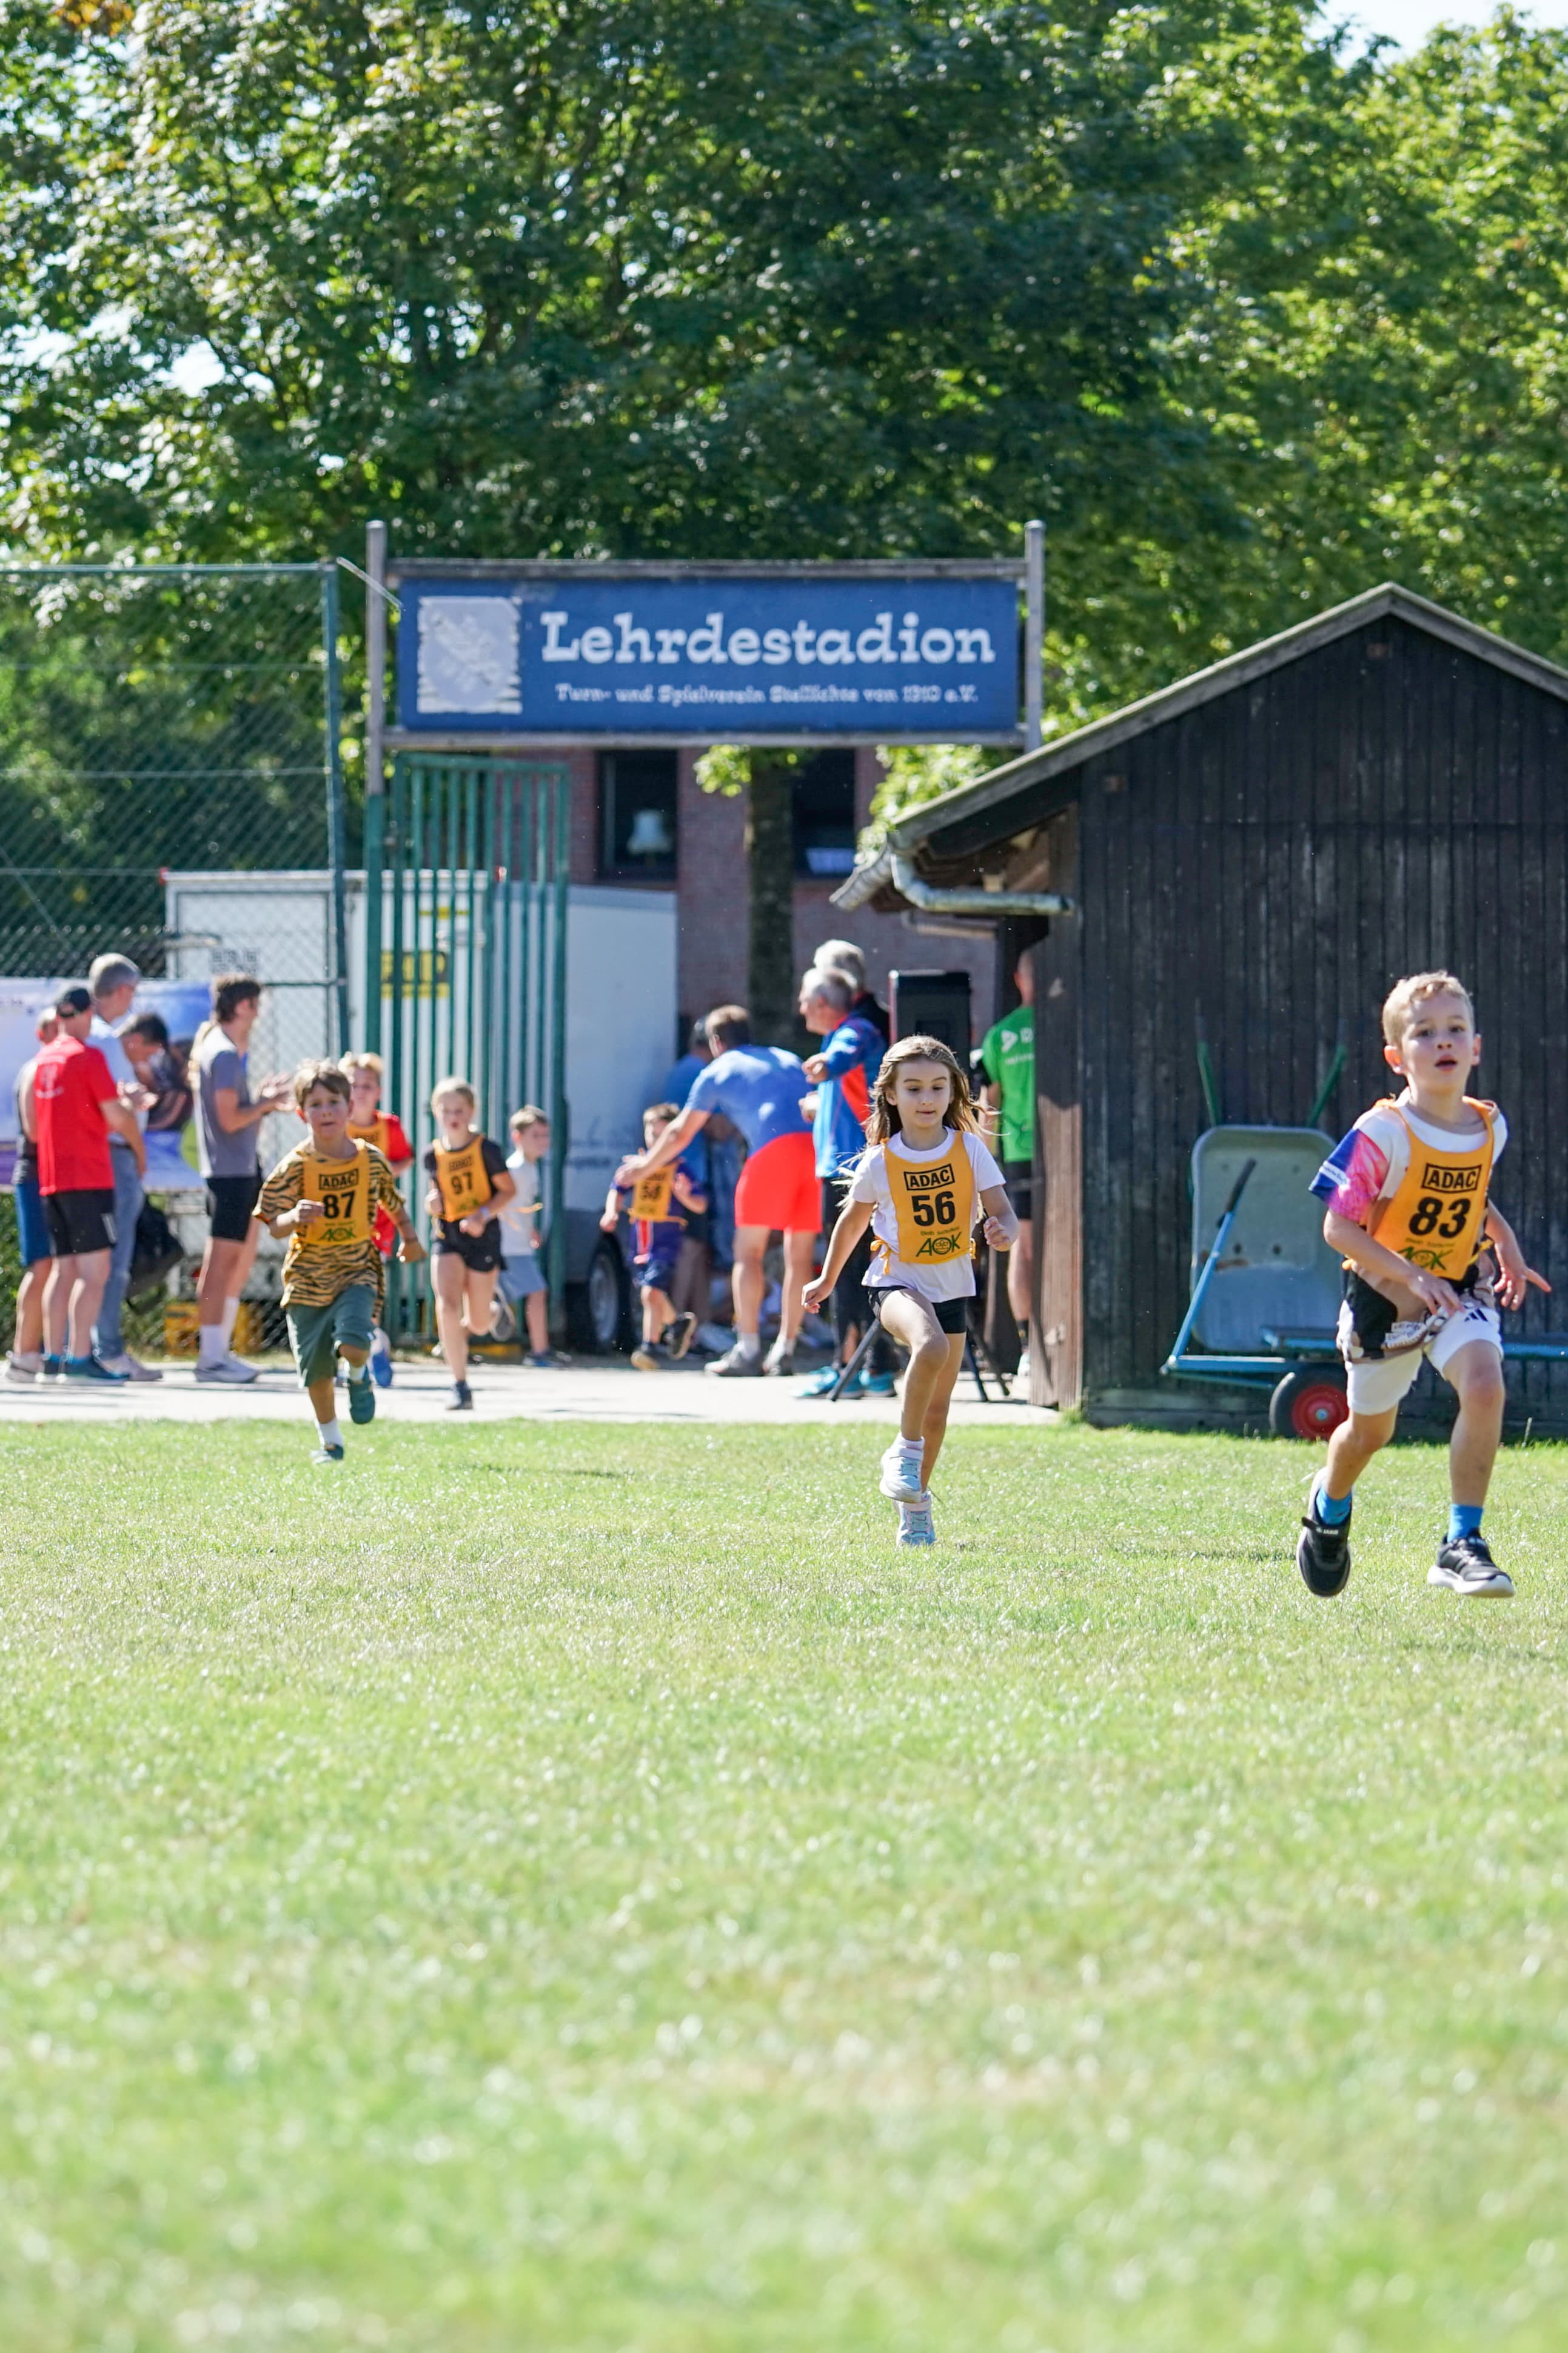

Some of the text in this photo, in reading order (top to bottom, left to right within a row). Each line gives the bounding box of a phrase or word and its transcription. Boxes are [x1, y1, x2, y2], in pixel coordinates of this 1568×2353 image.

[540, 611, 996, 665] Lehrdestadion
[554, 682, 611, 702] Turn-
[615, 685, 655, 703] und
[657, 684, 766, 708] Spielverein
[863, 687, 899, 703] von
[943, 684, 979, 703] e.V.
[323, 1172, 355, 1187] ADAC
[451, 1171, 472, 1195] 97
[910, 1169, 950, 1187] ADAC
[1427, 1169, 1477, 1189] ADAC
[323, 1190, 355, 1219] 87
[911, 1191, 956, 1226] 56
[1409, 1197, 1471, 1238] 83
[318, 1227, 357, 1241] AOK
[916, 1232, 962, 1257] AOK
[1398, 1246, 1454, 1270] AOK
